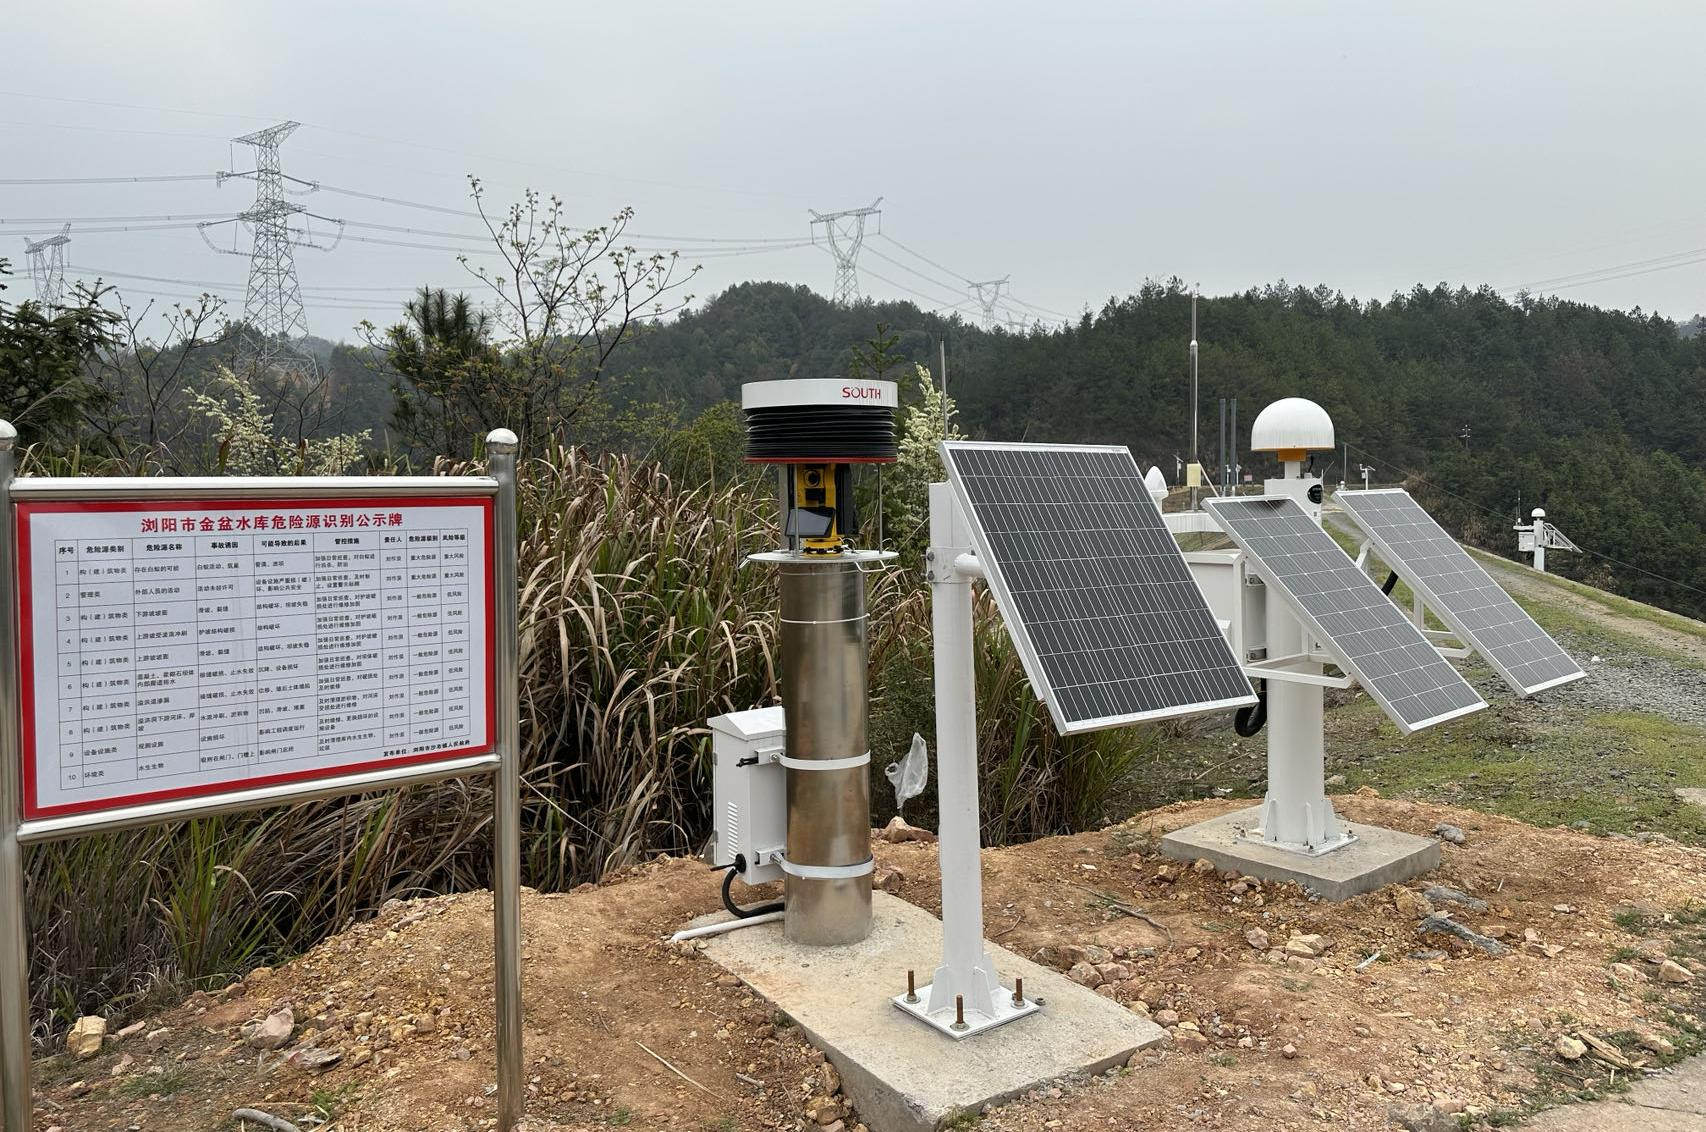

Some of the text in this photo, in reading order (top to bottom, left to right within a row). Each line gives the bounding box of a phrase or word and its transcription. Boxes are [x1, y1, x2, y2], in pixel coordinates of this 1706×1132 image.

[842, 387, 881, 399] SOUTH
[141, 513, 403, 533] 浏阳市金盆水库危险源识别公示牌
[210, 541, 239, 550] 事故诱因
[260, 538, 307, 548] 可能导致的后果
[334, 537, 360, 545] 管控措施
[59, 546, 74, 555] 序号
[85, 544, 125, 554] 危险源类别
[145, 543, 183, 552] 危险源名称
[80, 591, 100, 599] 管理类
